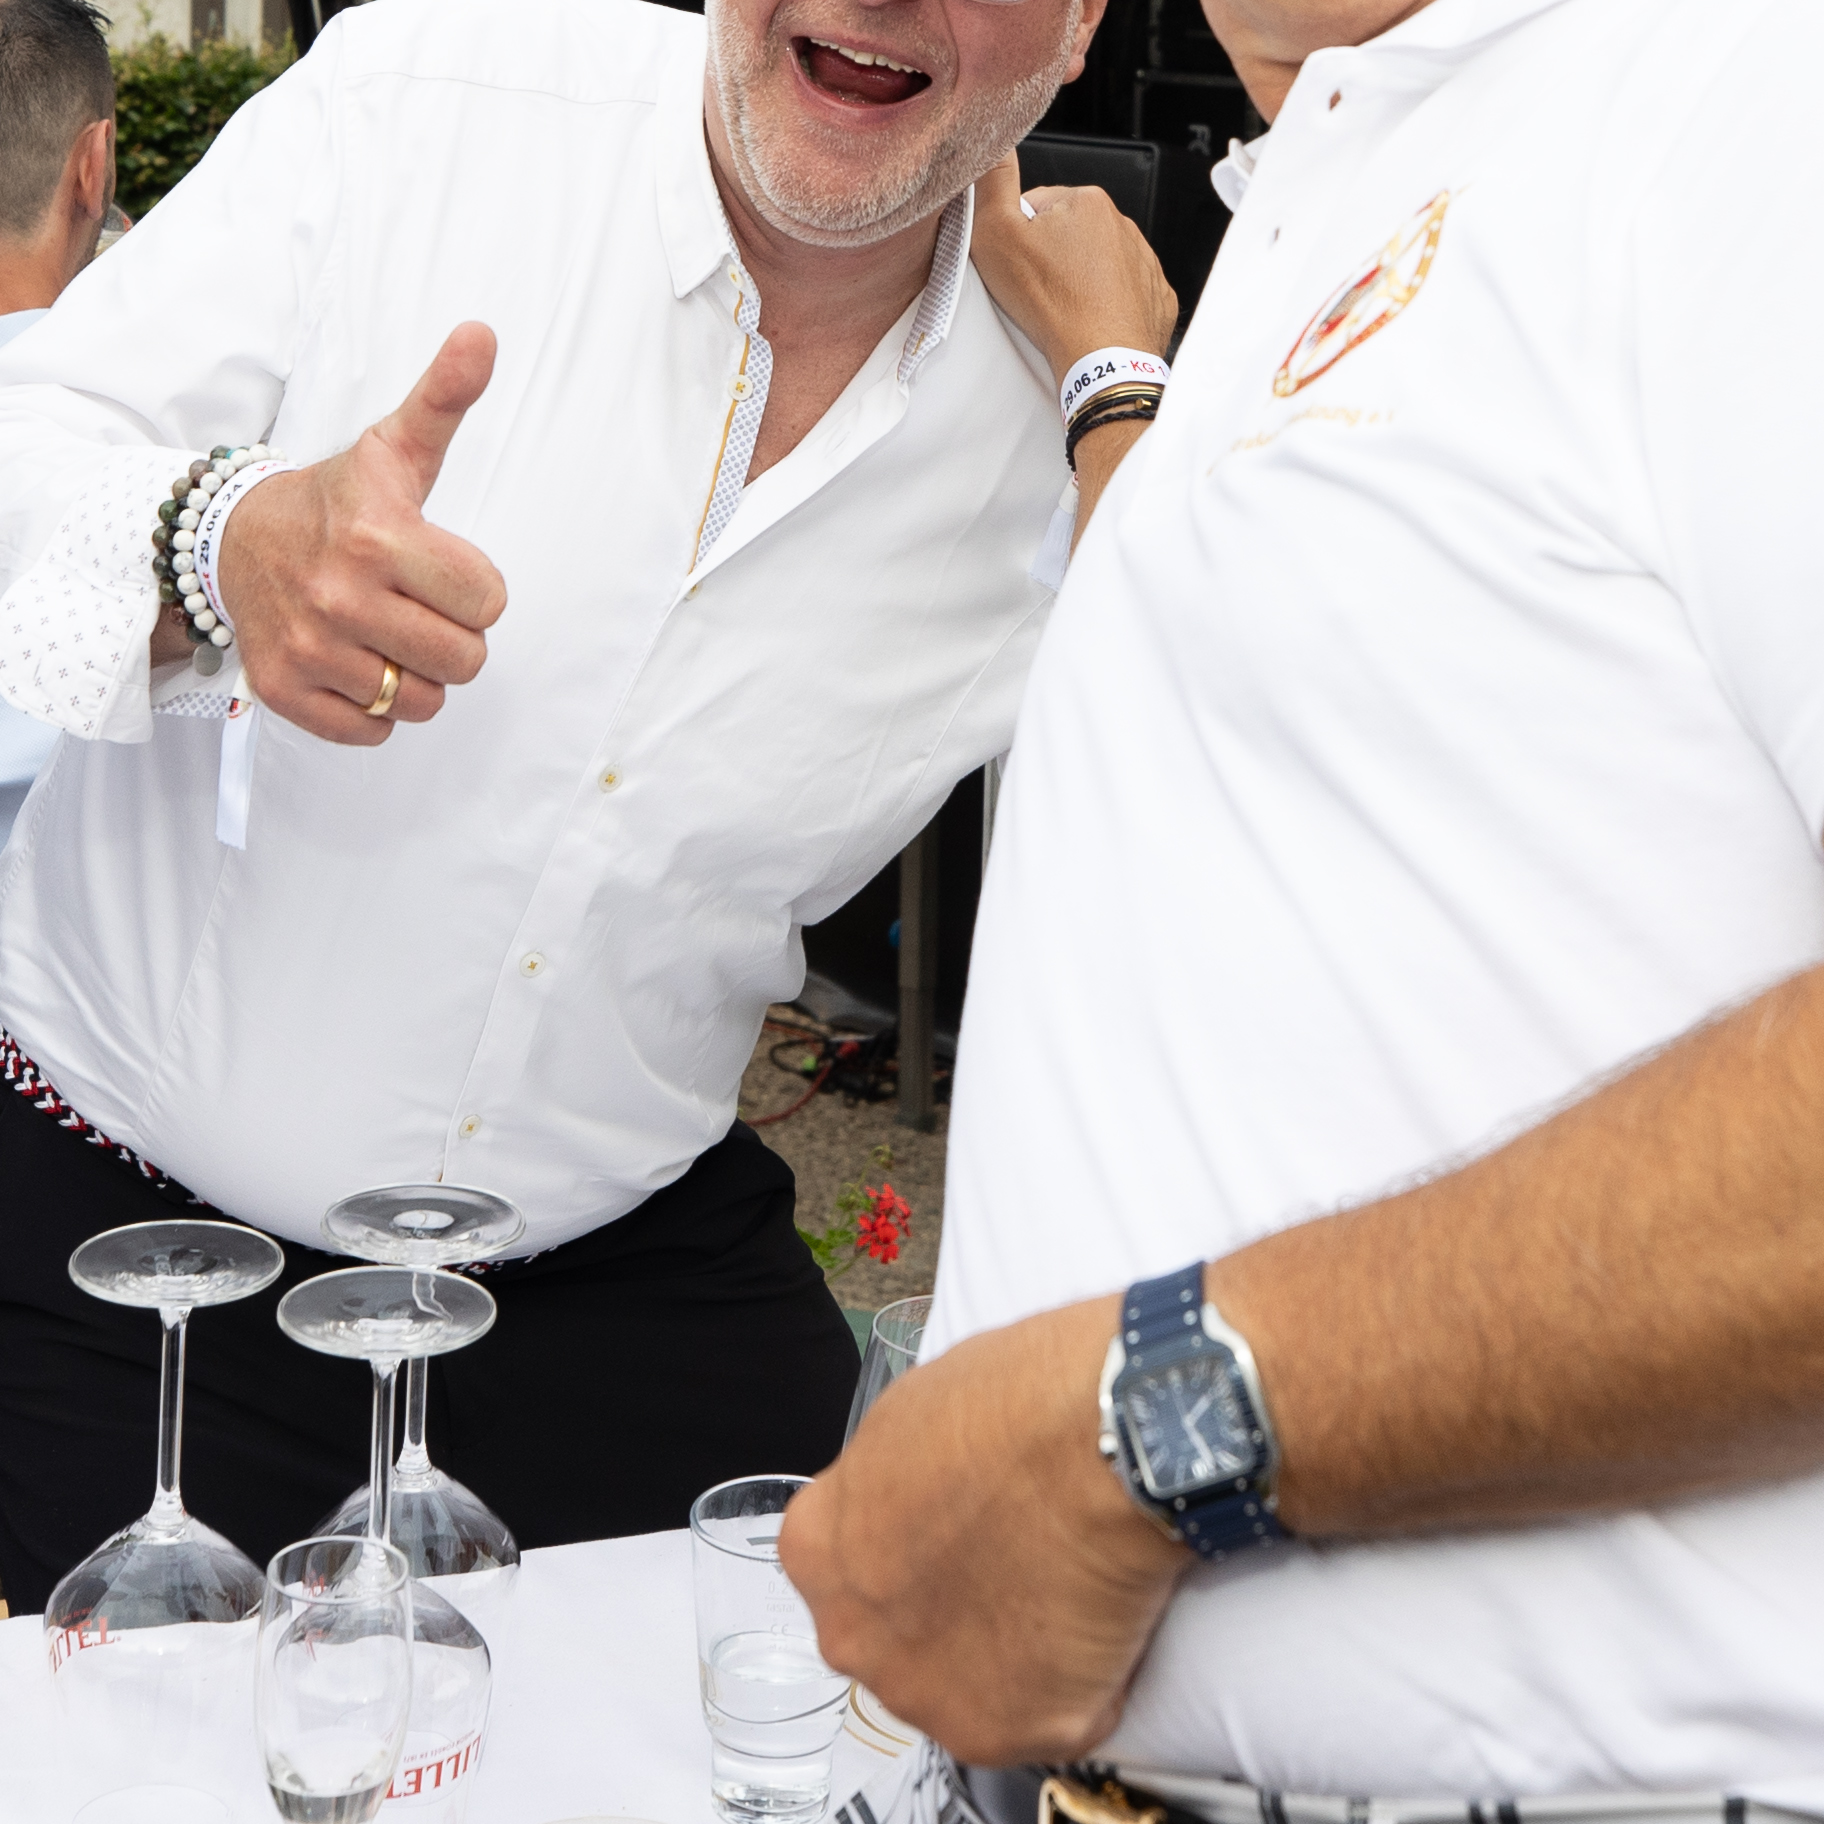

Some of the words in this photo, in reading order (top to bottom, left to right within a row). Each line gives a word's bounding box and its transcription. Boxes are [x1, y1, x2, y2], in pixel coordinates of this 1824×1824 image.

[1064, 361, 1116, 412] 29.06.24
[1129, 360, 1155, 374] KG
[199, 482, 243, 566] 29.06.24
